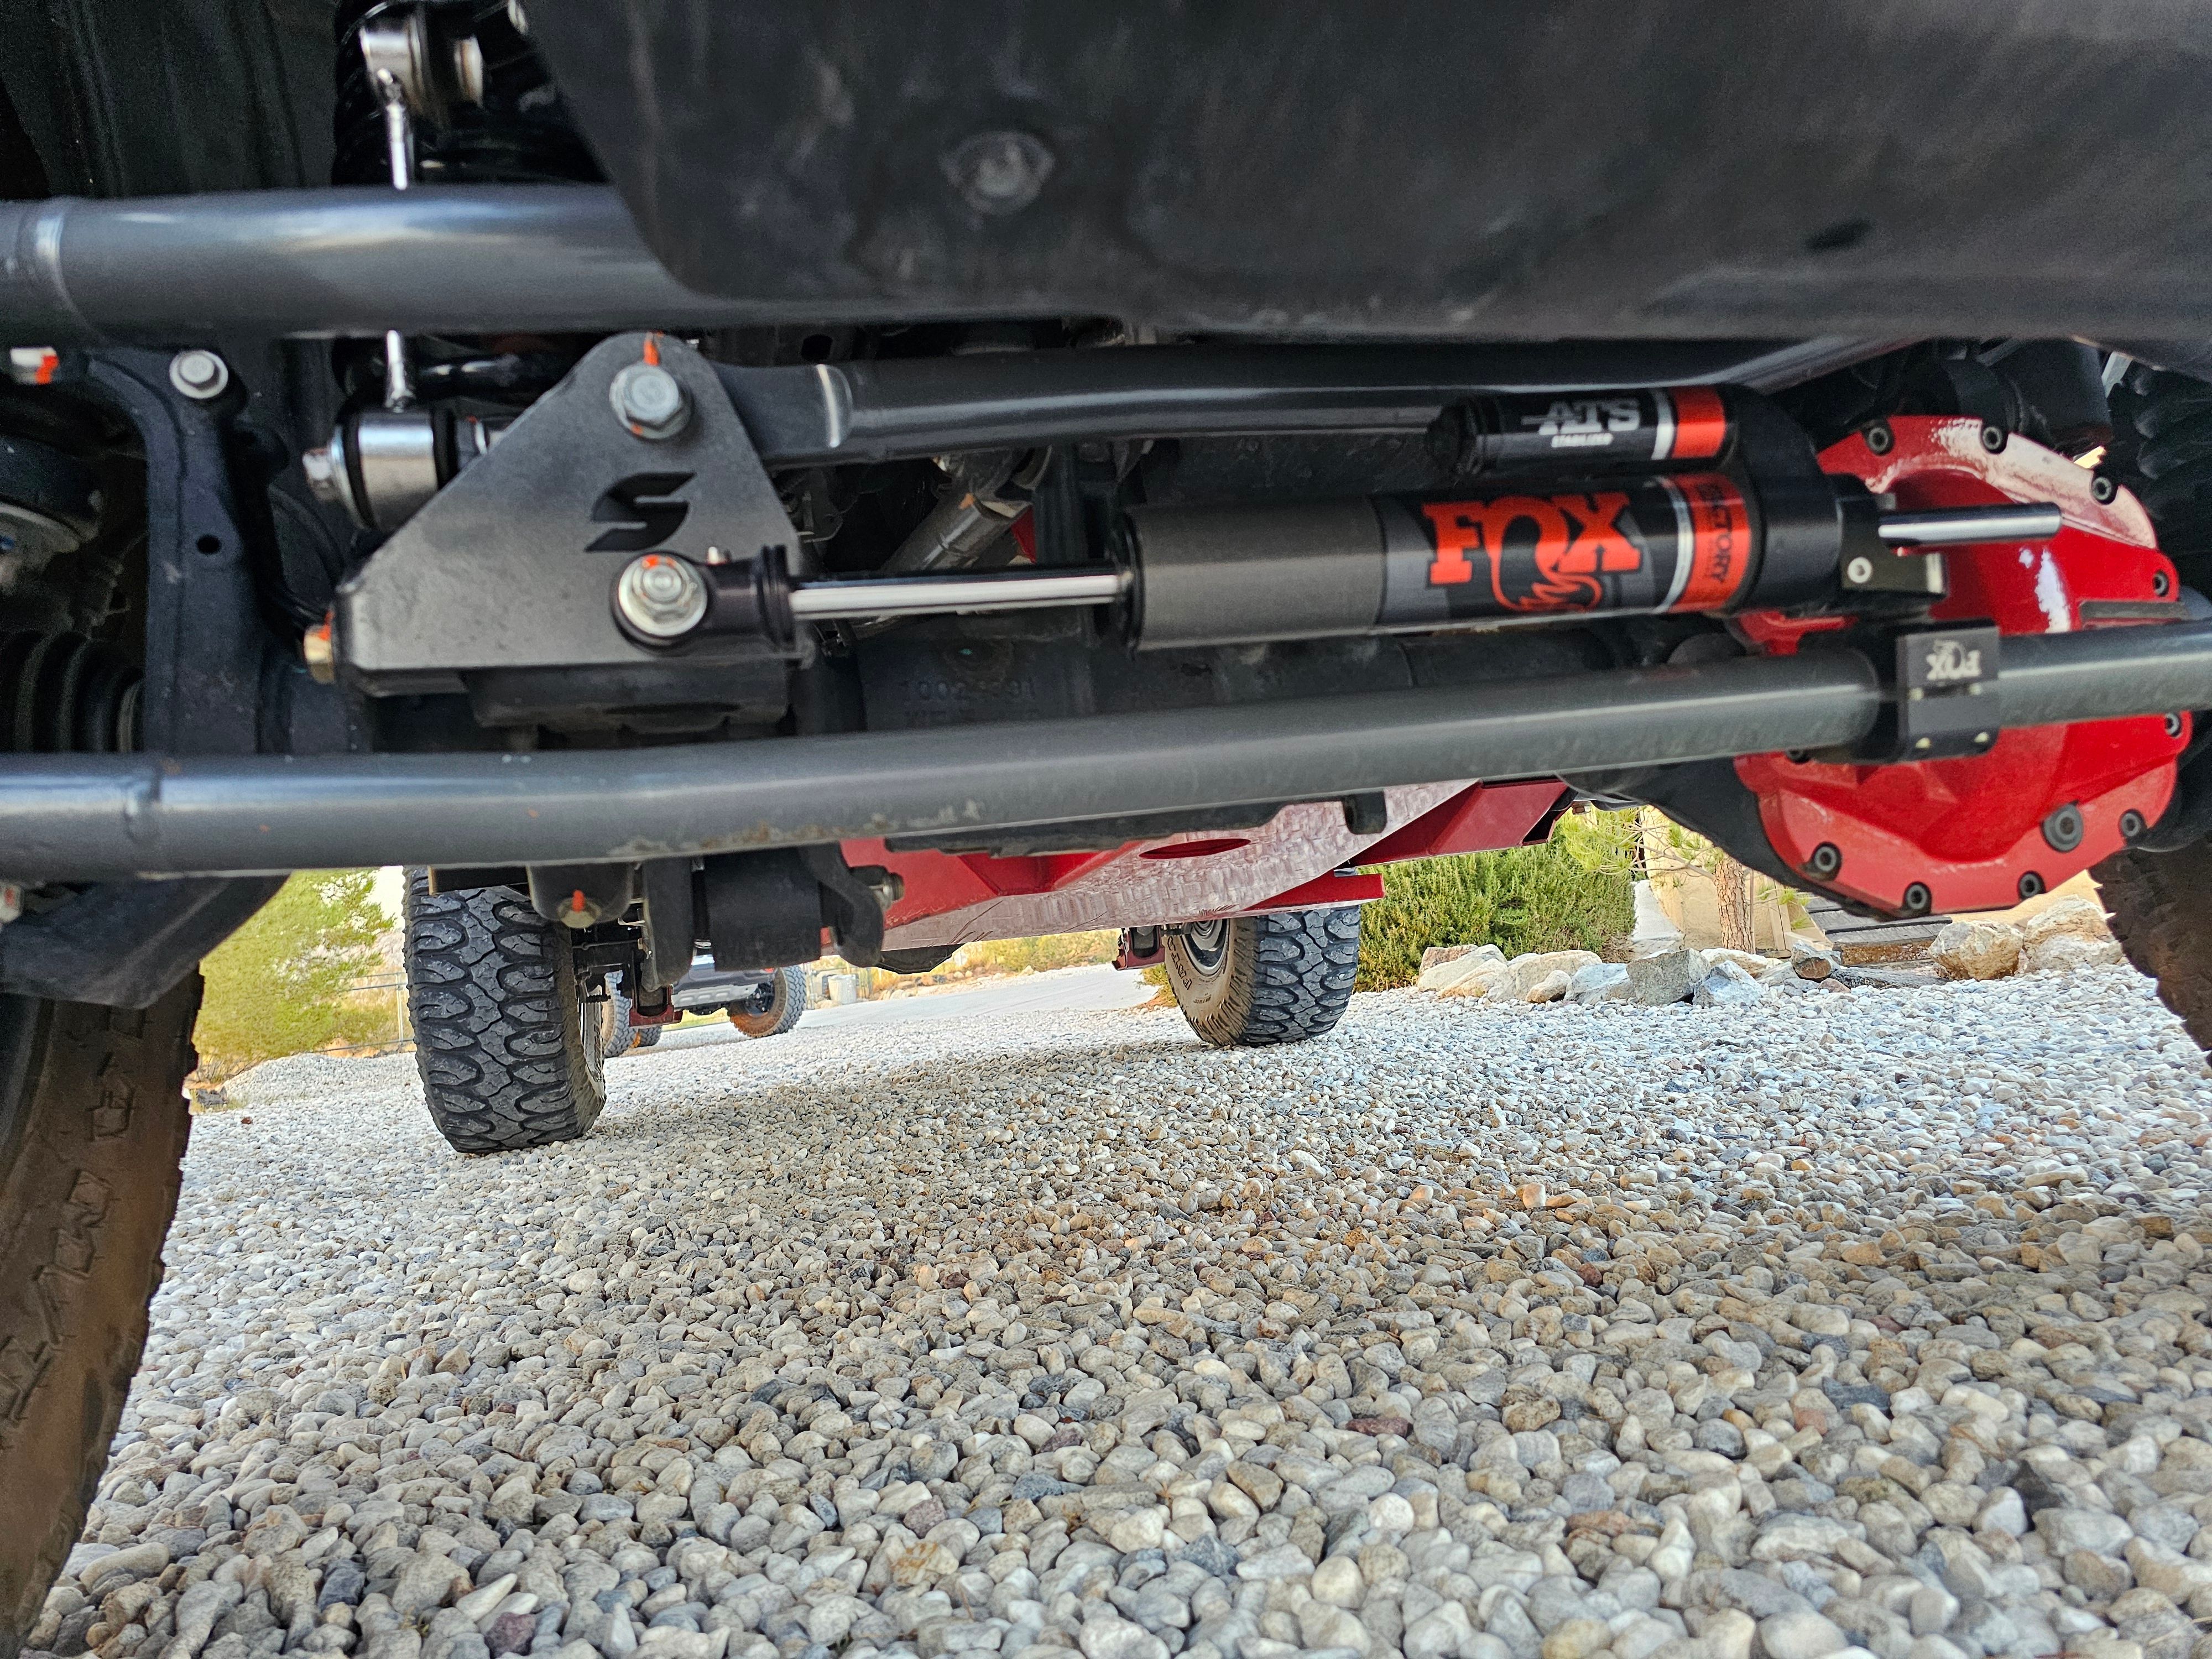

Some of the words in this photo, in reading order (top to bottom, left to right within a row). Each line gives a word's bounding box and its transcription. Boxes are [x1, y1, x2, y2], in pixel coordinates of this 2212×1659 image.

[1521, 397, 1641, 435] ATS
[1422, 492, 1641, 612] FOX
[1926, 639, 1981, 681] FOX
